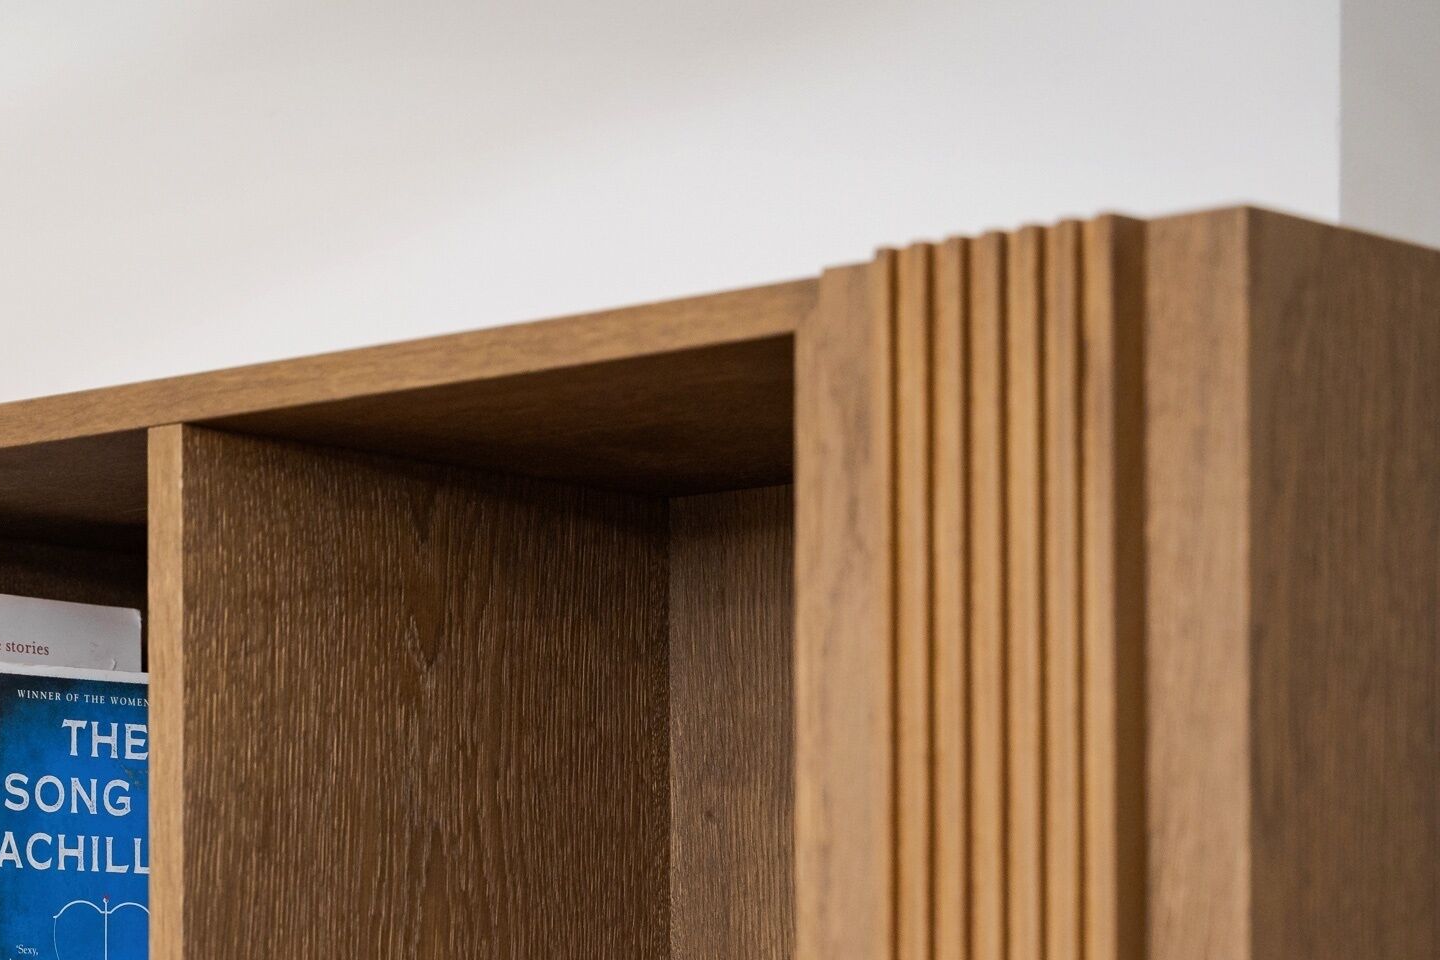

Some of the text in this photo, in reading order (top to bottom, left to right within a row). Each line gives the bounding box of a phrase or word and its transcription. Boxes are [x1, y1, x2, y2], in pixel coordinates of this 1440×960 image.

[6, 640, 50, 656] stories
[17, 689, 61, 701] WINNER
[66, 693, 80, 702] OF
[84, 694, 106, 704] THE
[62, 718, 149, 761] THE
[4, 772, 132, 817] SONG
